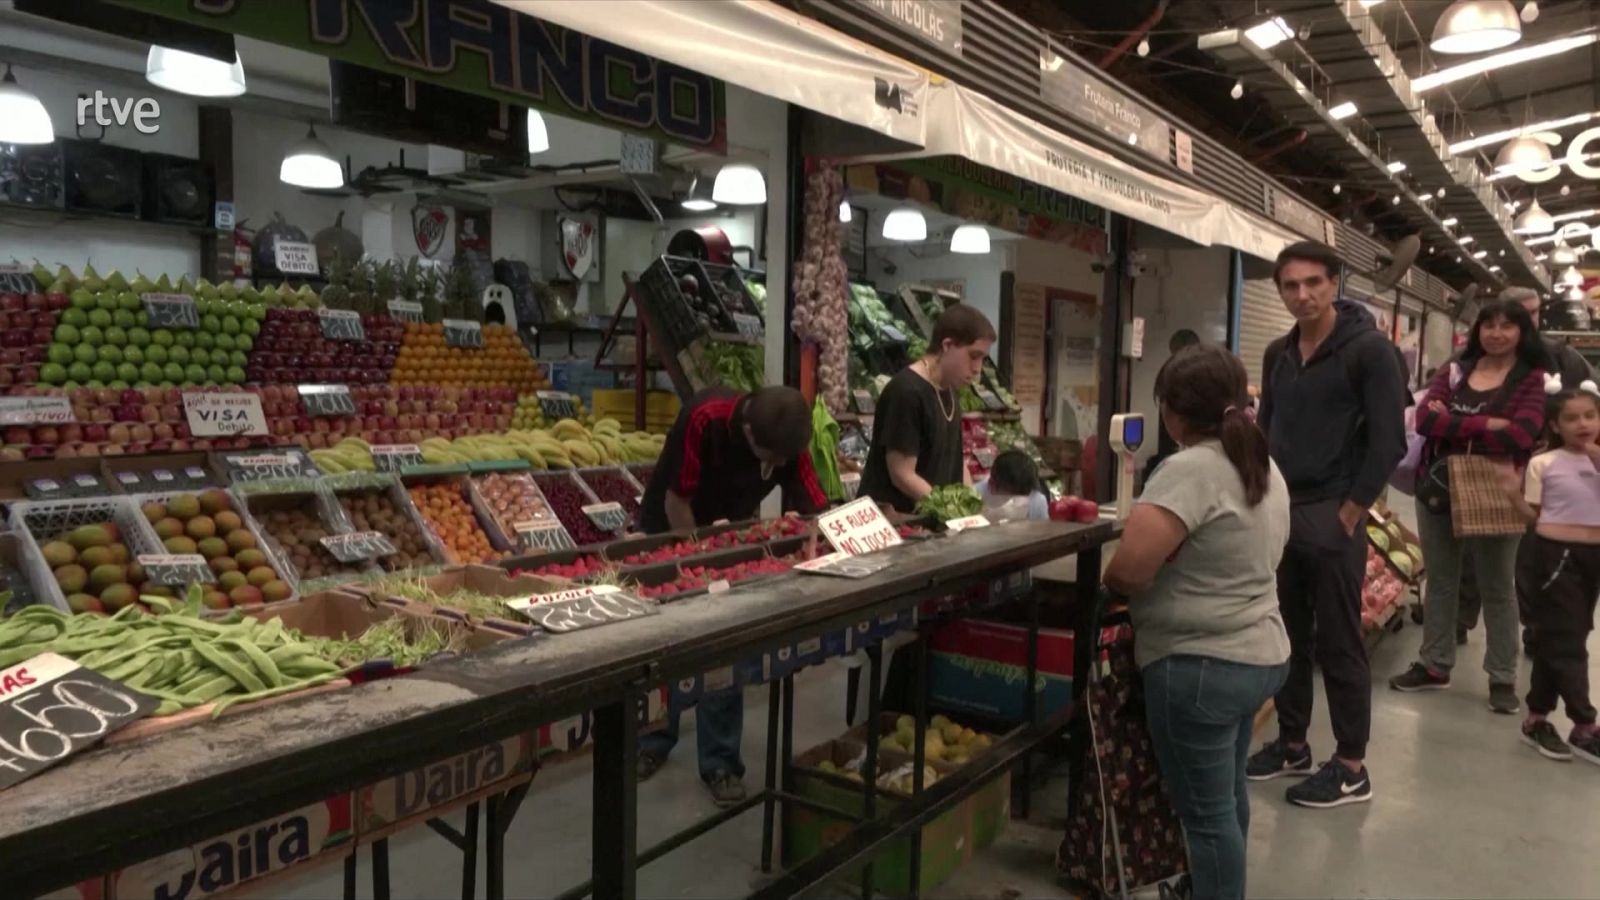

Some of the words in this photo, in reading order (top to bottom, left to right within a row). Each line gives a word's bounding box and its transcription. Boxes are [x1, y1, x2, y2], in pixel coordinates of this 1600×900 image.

[192, 0, 714, 144] RANCO
[195, 409, 248, 421] VISA
[828, 519, 848, 537] SE
[839, 536, 864, 557] NO
